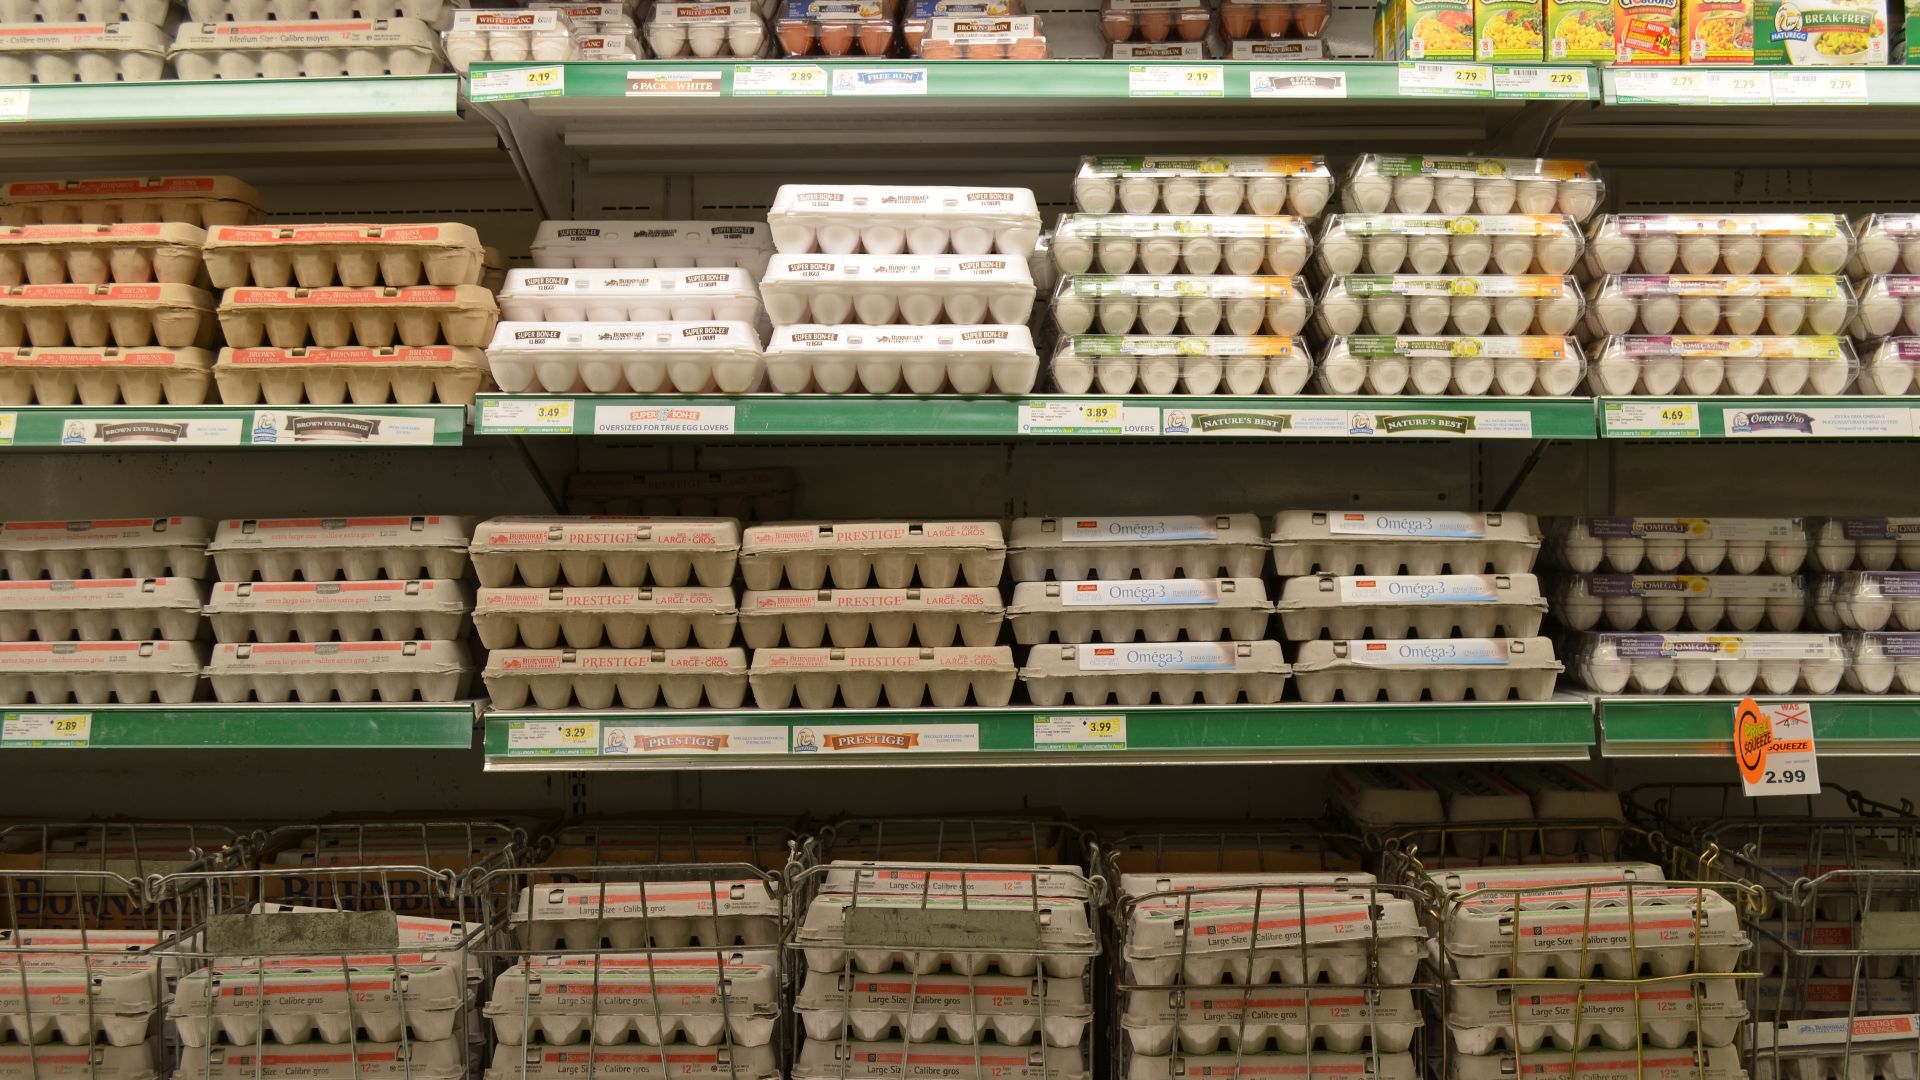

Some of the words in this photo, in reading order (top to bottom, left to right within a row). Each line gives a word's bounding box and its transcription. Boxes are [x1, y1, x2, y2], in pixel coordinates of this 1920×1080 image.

[10, 36, 34, 45] Calibre
[229, 35, 256, 43] Medium
[280, 34, 304, 42] Calibre
[1772, 33, 1807, 41] NATUREGG
[529, 73, 550, 81] 2.19
[790, 72, 812, 80] 2.89
[1187, 73, 1208, 81] 2.19
[1456, 71, 1477, 80] 2.79
[1551, 74, 1572, 82] 2.79
[1672, 76, 1693, 86] 2.79
[1734, 79, 1754, 88] 2.79
[1830, 79, 1851, 89] 2.79
[640, 82, 667, 90] PACK
[677, 82, 713, 90] WHITE
[960, 262, 979, 270] SUPER
[687, 275, 705, 283] SUPER
[684, 328, 704, 336] SUPER
[963, 332, 982, 340] SUPER
[538, 408, 560, 416] 3.49
[631, 412, 657, 420] SUPER
[1087, 408, 1108, 417] 3.89
[1662, 411, 1683, 419] 4.69
[1204, 417, 1251, 428] NATURE'S
[1253, 418, 1279, 428] BEST
[1751, 414, 1784, 424] Omega
[1785, 414, 1805, 424] Pro
[297, 420, 322, 429] BROWN
[346, 421, 369, 430] LARGE
[1389, 419, 1436, 429] NATURE'S
[1438, 419, 1463, 429] BEST
[106, 427, 131, 435] BROWN
[1109, 522, 1165, 537] Oméga-3
[1377, 517, 1432, 533] Oméga-3
[927, 529, 956, 537] LARGE
[658, 535, 686, 544] LARGE
[692, 536, 715, 544] GROS
[1109, 585, 1165, 601] Oméga-3
[1388, 582, 1446, 598] Oméga-3
[656, 596, 684, 604] LARGE
[927, 597, 955, 605] LARGE
[961, 597, 984, 605] GROS
[1400, 645, 1456, 661] Oméga-3
[940, 657, 969, 665] LARGE
[974, 657, 997, 665] GROS
[1127, 650, 1183, 666] Oméga-3
[671, 659, 700, 667] LARGE
[705, 659, 728, 667] GROS
[57, 722, 77, 730] 2.89
[1091, 723, 1111, 731] 3.99
[565, 728, 585, 737] 3.29
[649, 737, 714, 747] PRESTIGE
[838, 735, 904, 746] PRESTIGE
[1745, 732, 1771, 755] SQUEEZE
[1765, 770, 1805, 783] 2.99
[889, 882, 909, 890] Large
[933, 882, 956, 890] Calibre
[1003, 882, 1013, 890] 12
[579, 907, 599, 915] Large
[650, 905, 666, 913] gros
[1208, 937, 1229, 946] Large
[1232, 935, 1247, 944] Size
[1256, 933, 1282, 942] Calibre
[1334, 925, 1344, 934] 12
[1534, 938, 1552, 947] Large
[1555, 937, 1573, 945] Size
[1608, 935, 1627, 944] gros
[1659, 931, 1669, 940] 12
[280, 997, 304, 1005] Calibre
[356, 993, 365, 1002] 12
[558, 996, 578, 1005] Large
[604, 996, 630, 1005] Calibre
[869, 995, 889, 1004] Large
[891, 996, 906, 1004] Size
[916, 996, 942, 1004] Calibre
[944, 997, 960, 1005] gros
[992, 996, 1002, 1006] 12
[1532, 1007, 1552, 1016] Large
[1608, 1005, 1625, 1014] gros
[1657, 1002, 1668, 1011] 12
[1204, 1012, 1225, 1021] Large
[1252, 1011, 1279, 1019] Calibre
[1281, 1012, 1298, 1020] gros
[1331, 1008, 1340, 1017] 12
[285, 1067, 310, 1075] Calibre
[361, 1064, 371, 1072] 12
[558, 1064, 578, 1074] Large
[605, 1064, 631, 1073] Calibre
[681, 1065, 691, 1073] 12
[867, 1065, 888, 1075] Large
[915, 1066, 941, 1075] Calibre
[943, 1067, 959, 1075] gros
[992, 1067, 1001, 1076] 12
